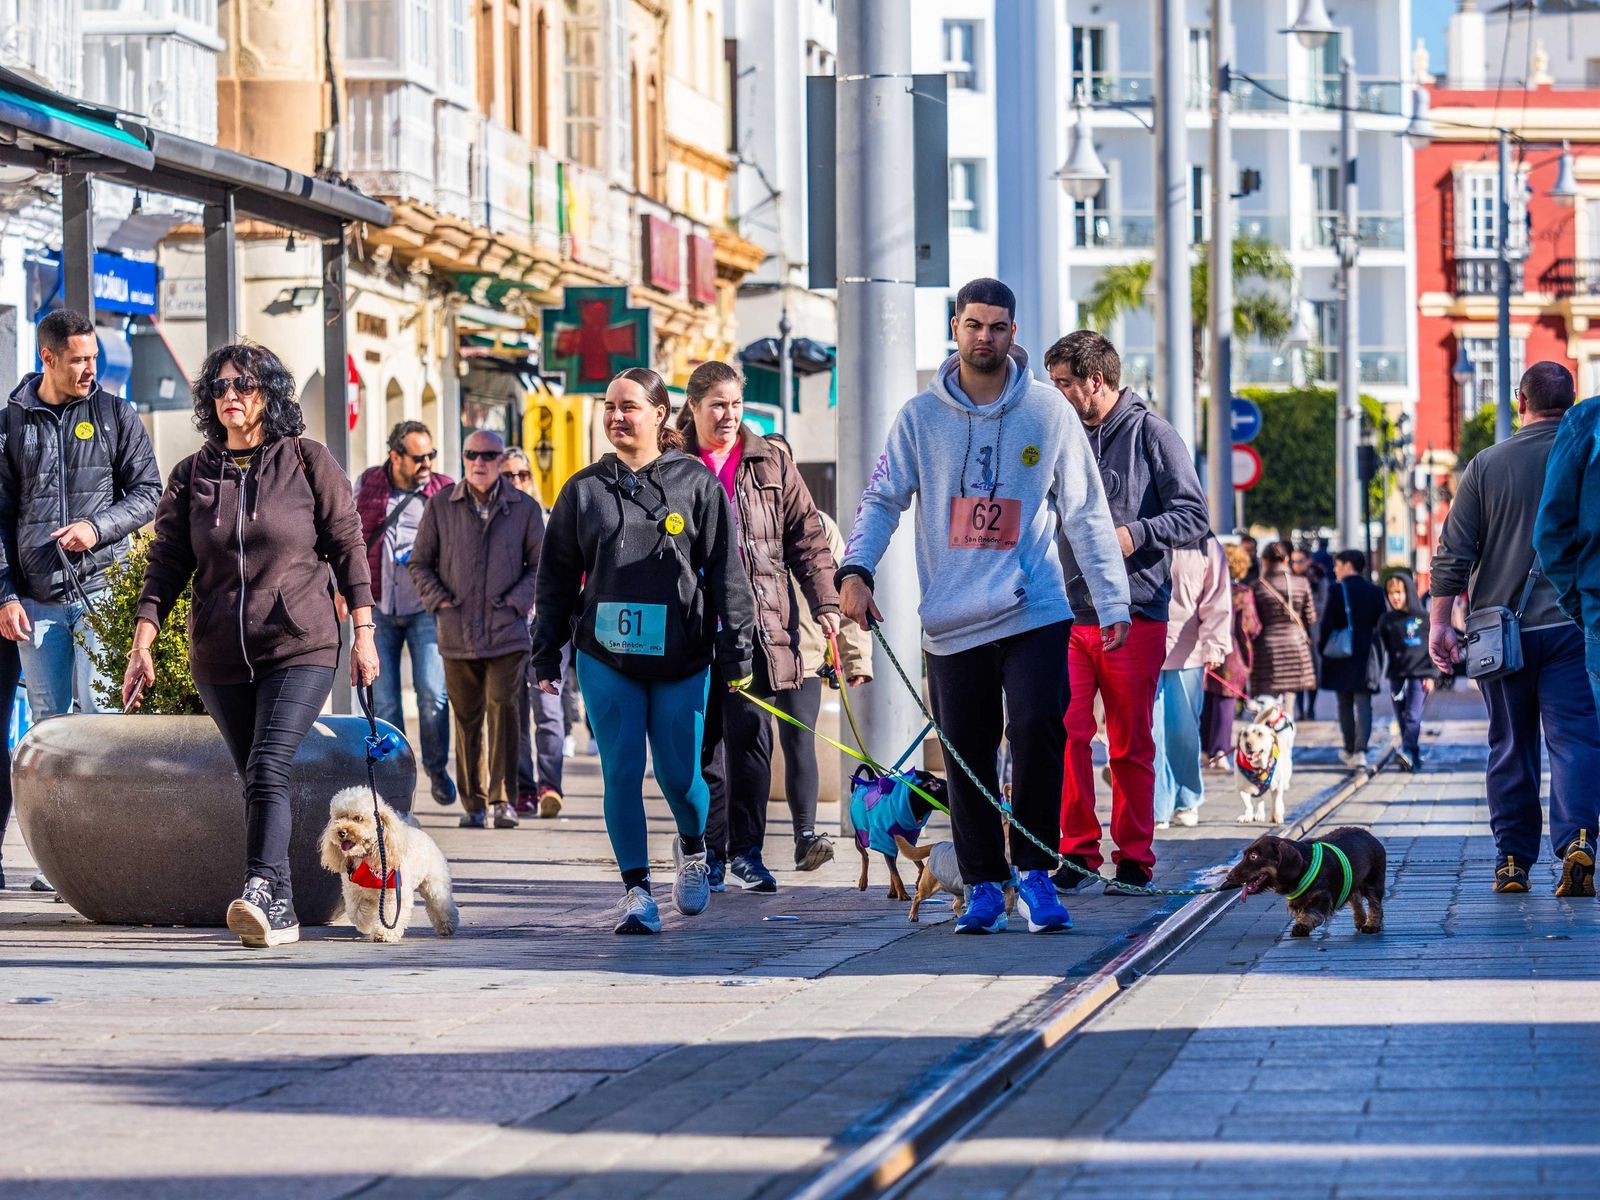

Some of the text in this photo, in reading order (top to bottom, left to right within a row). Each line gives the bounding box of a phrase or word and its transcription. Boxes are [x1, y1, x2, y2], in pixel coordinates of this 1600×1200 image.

[973, 503, 1002, 531] 62
[964, 535, 977, 544] San
[618, 608, 643, 637] 61
[609, 640, 621, 648] San
